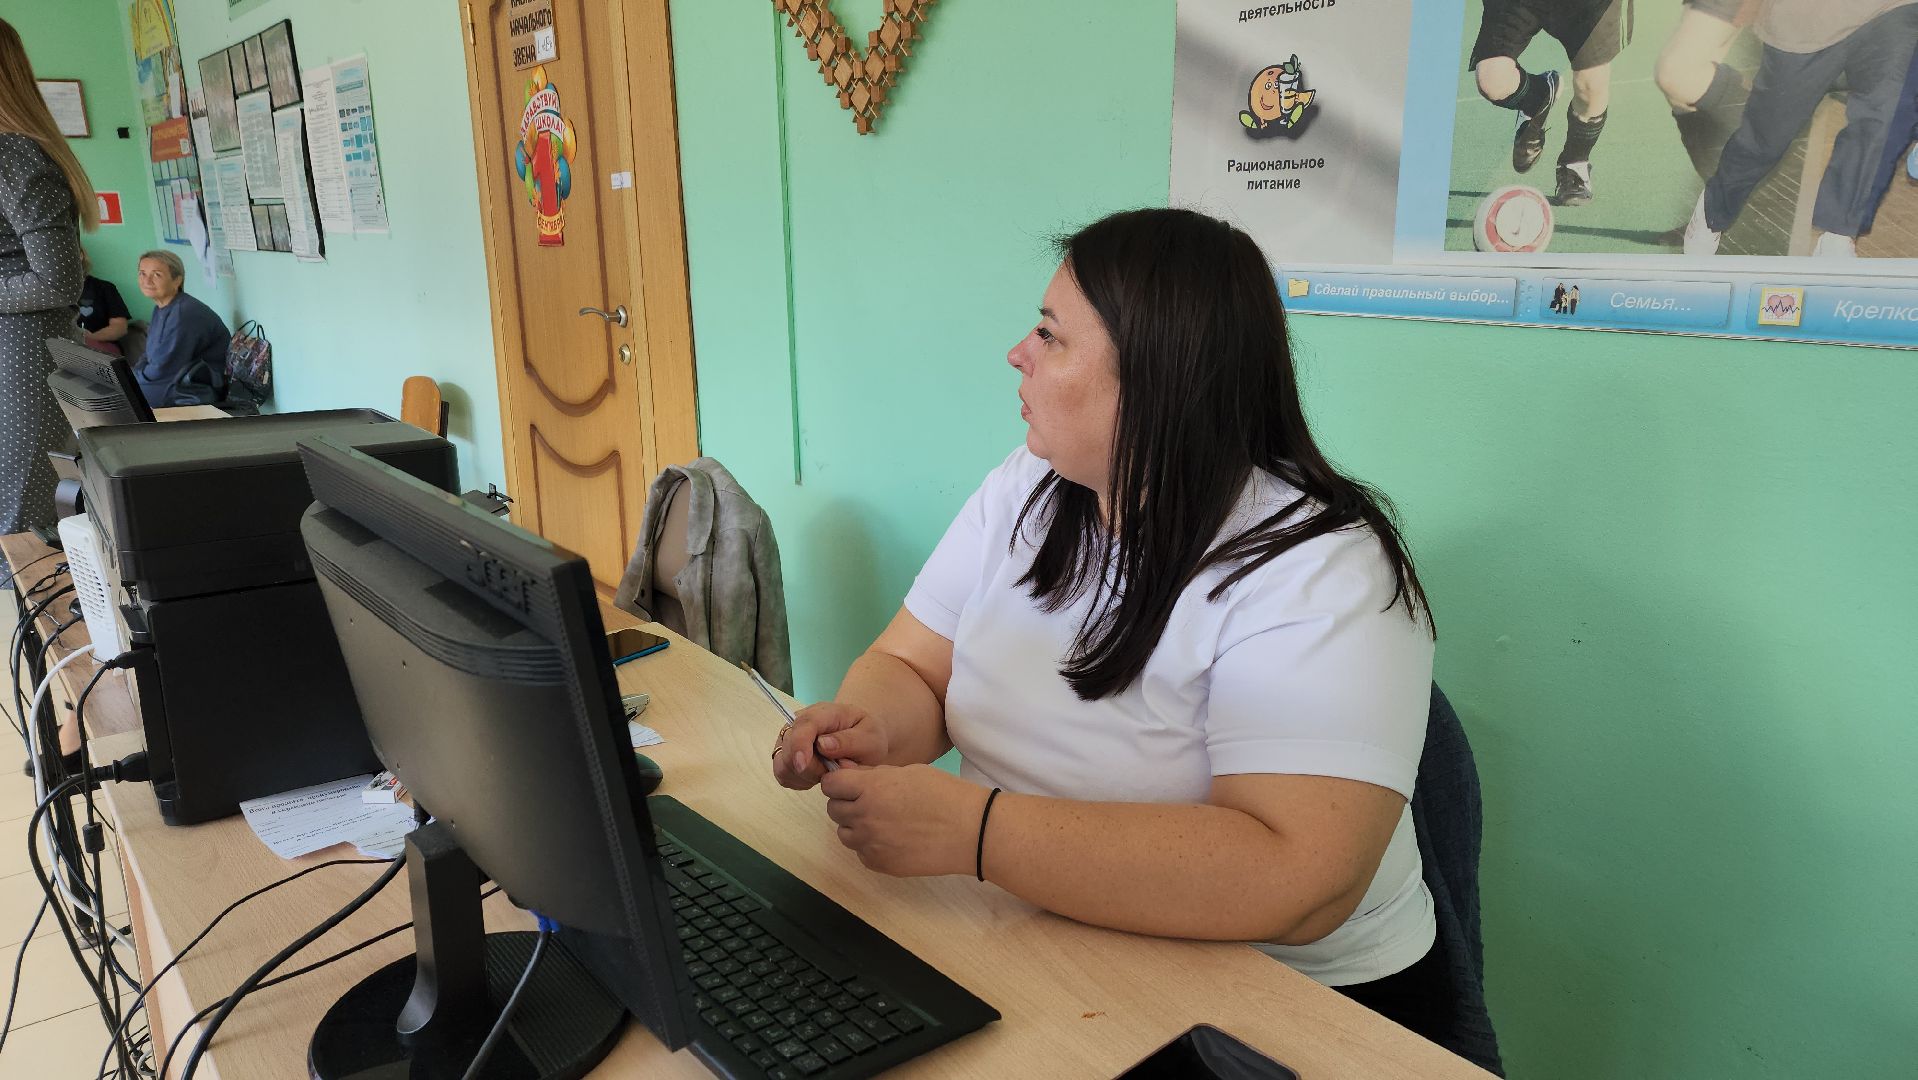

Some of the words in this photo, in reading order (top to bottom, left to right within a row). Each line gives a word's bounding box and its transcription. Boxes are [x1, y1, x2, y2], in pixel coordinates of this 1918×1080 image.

[510, 8, 552, 37] НАЧАЛЬНОГО
[1239, 0, 1335, 23] деятельность
[513, 44, 537, 67] ЗВЕНА
[1227, 157, 1325, 173] Рациональное
[1247, 178, 1301, 190] питание
[1314, 283, 1359, 296] Сделай
[1362, 287, 1446, 300] правильный
[1450, 292, 1509, 305] выбор...
[1610, 292, 1692, 311] Семья...
[1833, 300, 1918, 322] Крепко
